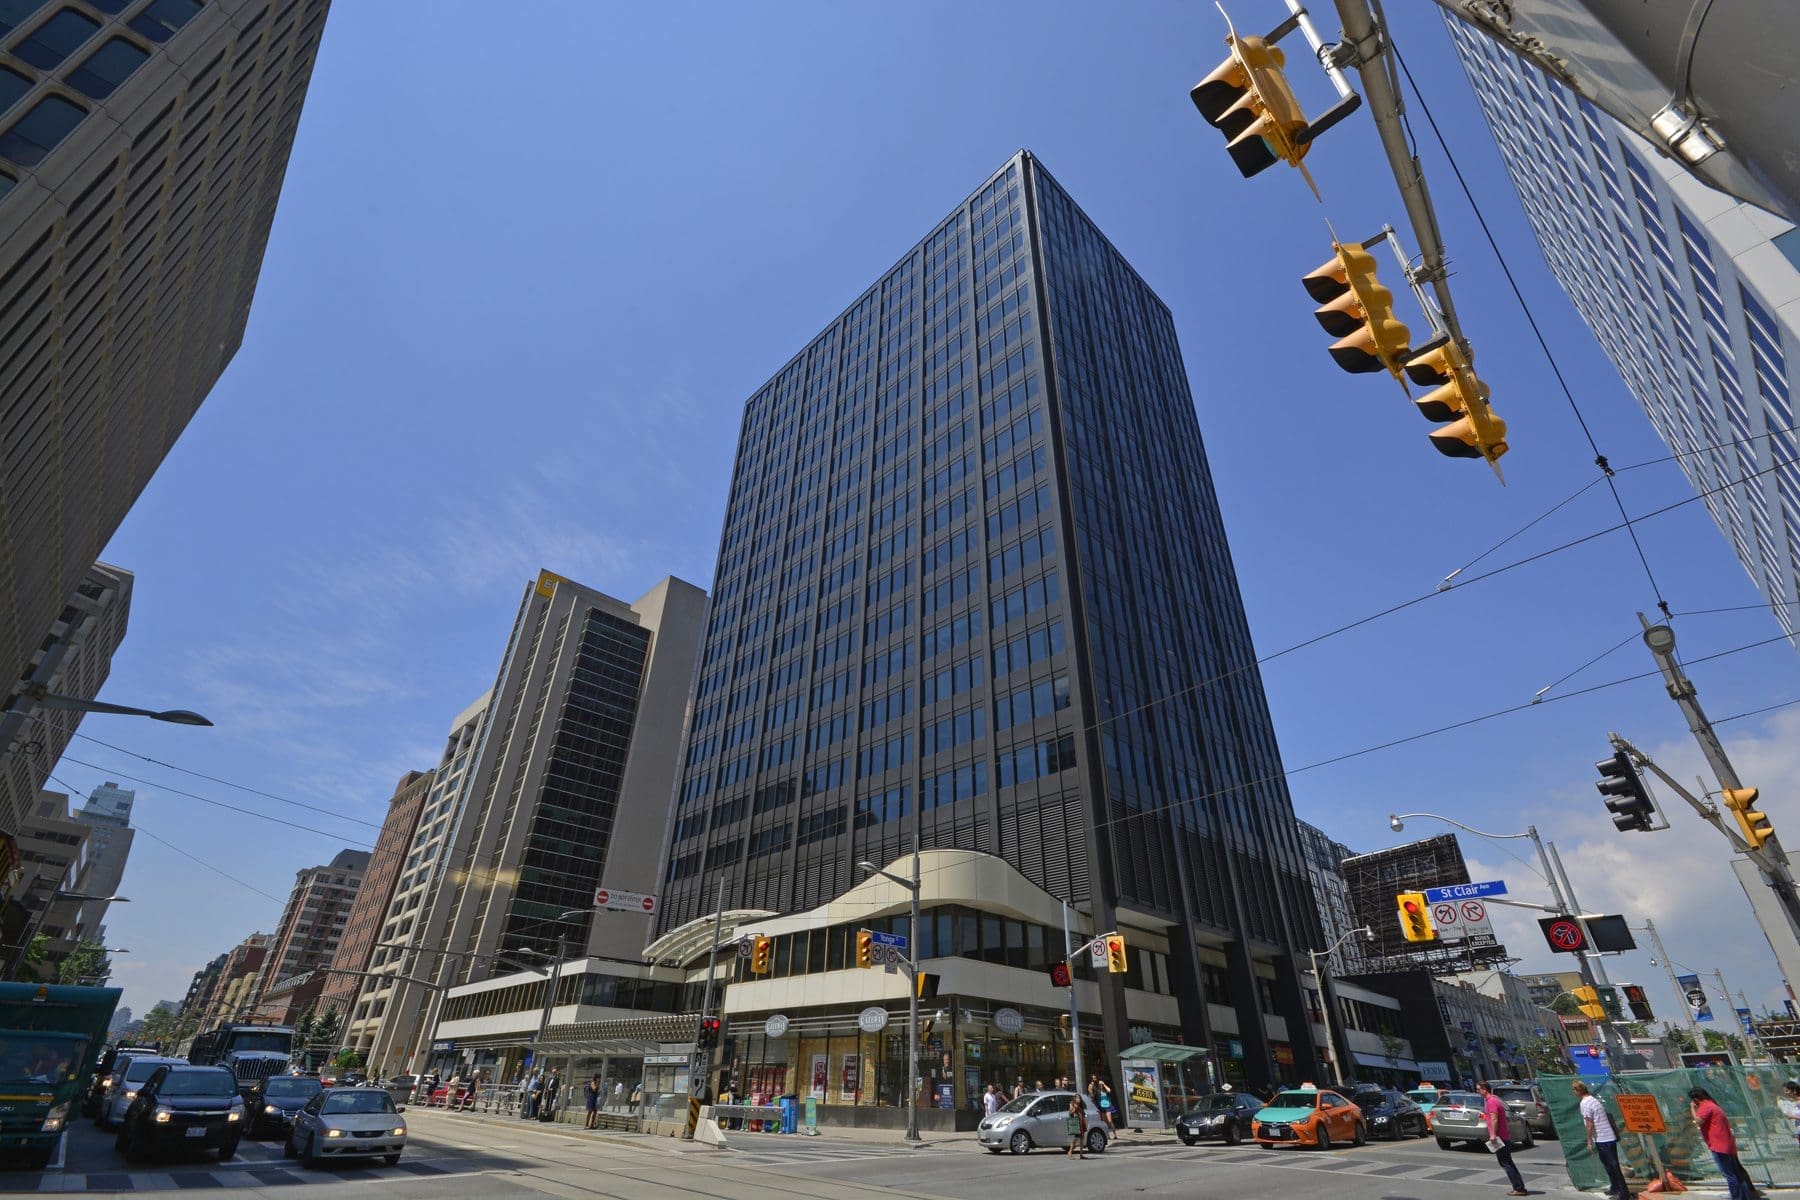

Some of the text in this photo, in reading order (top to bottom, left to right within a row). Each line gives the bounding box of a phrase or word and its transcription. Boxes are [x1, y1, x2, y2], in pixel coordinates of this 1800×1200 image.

[1440, 888, 1453, 898] St
[1454, 886, 1479, 897] Clair
[880, 935, 896, 944] Yonge
[1471, 939, 1496, 947] EXCEPTED
